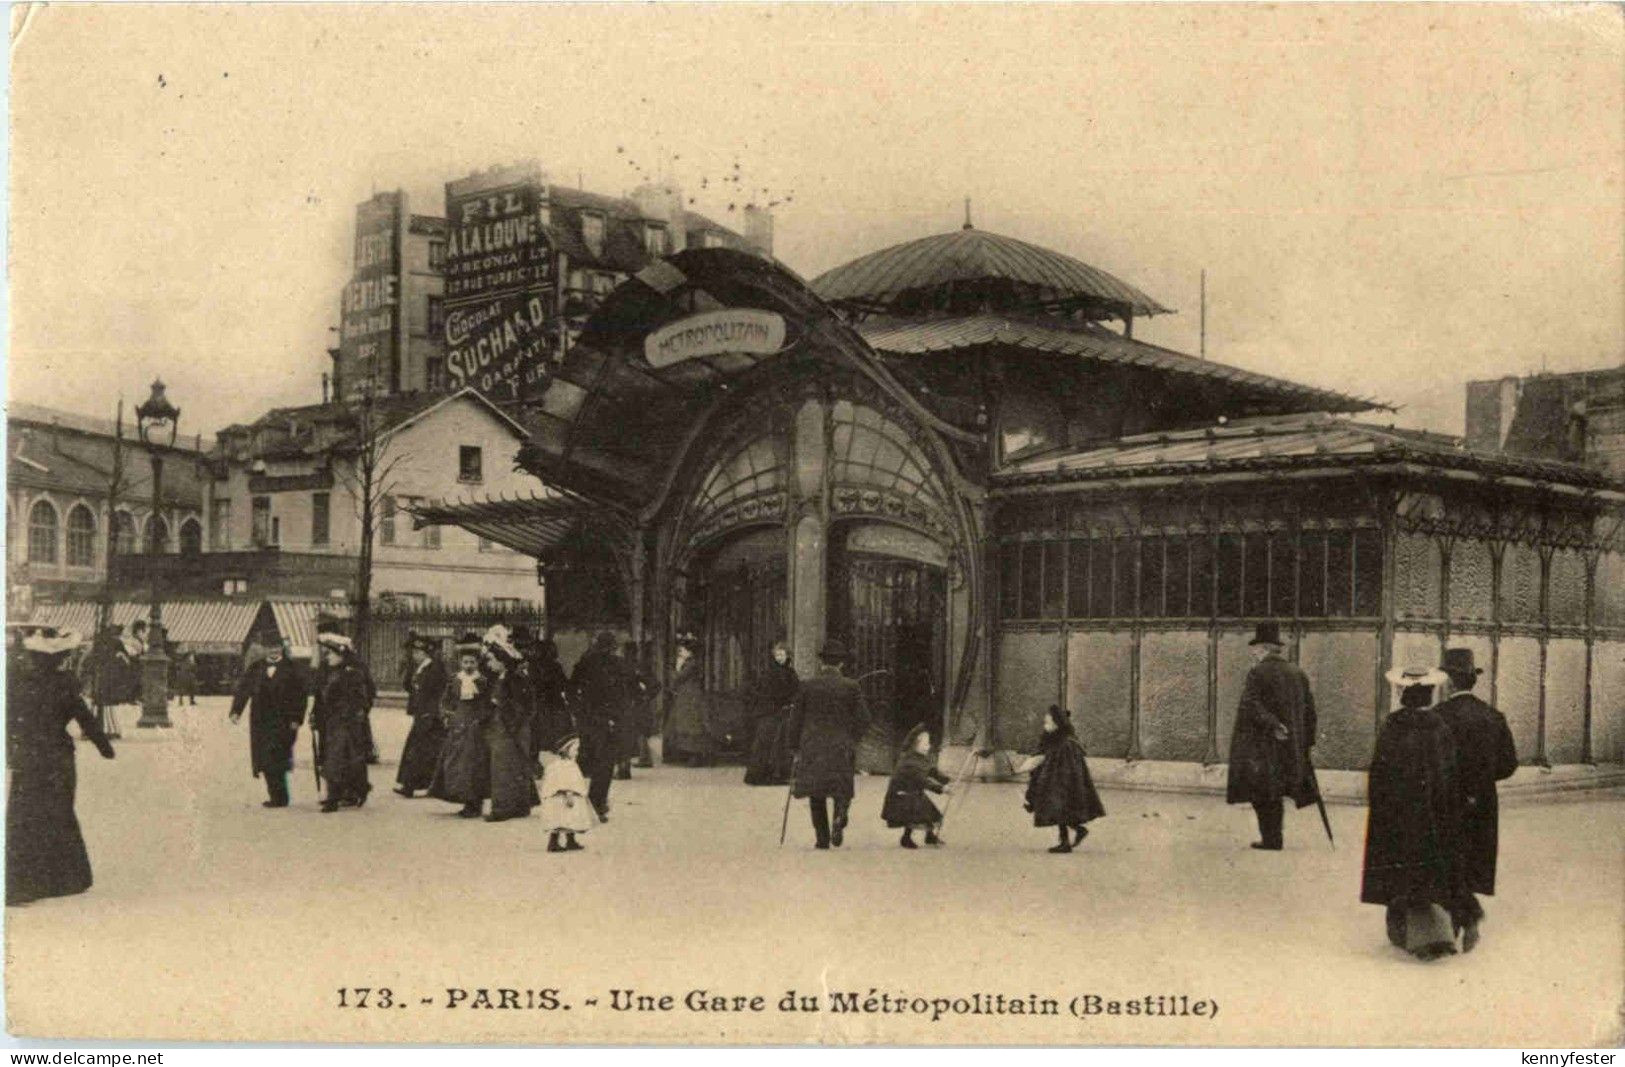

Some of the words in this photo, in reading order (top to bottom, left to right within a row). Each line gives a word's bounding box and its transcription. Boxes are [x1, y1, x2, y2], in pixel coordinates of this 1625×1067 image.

[462, 193, 523, 223] FIL
[446, 301, 501, 346] CHOCOLAT
[447, 298, 544, 387] SUCHARD
